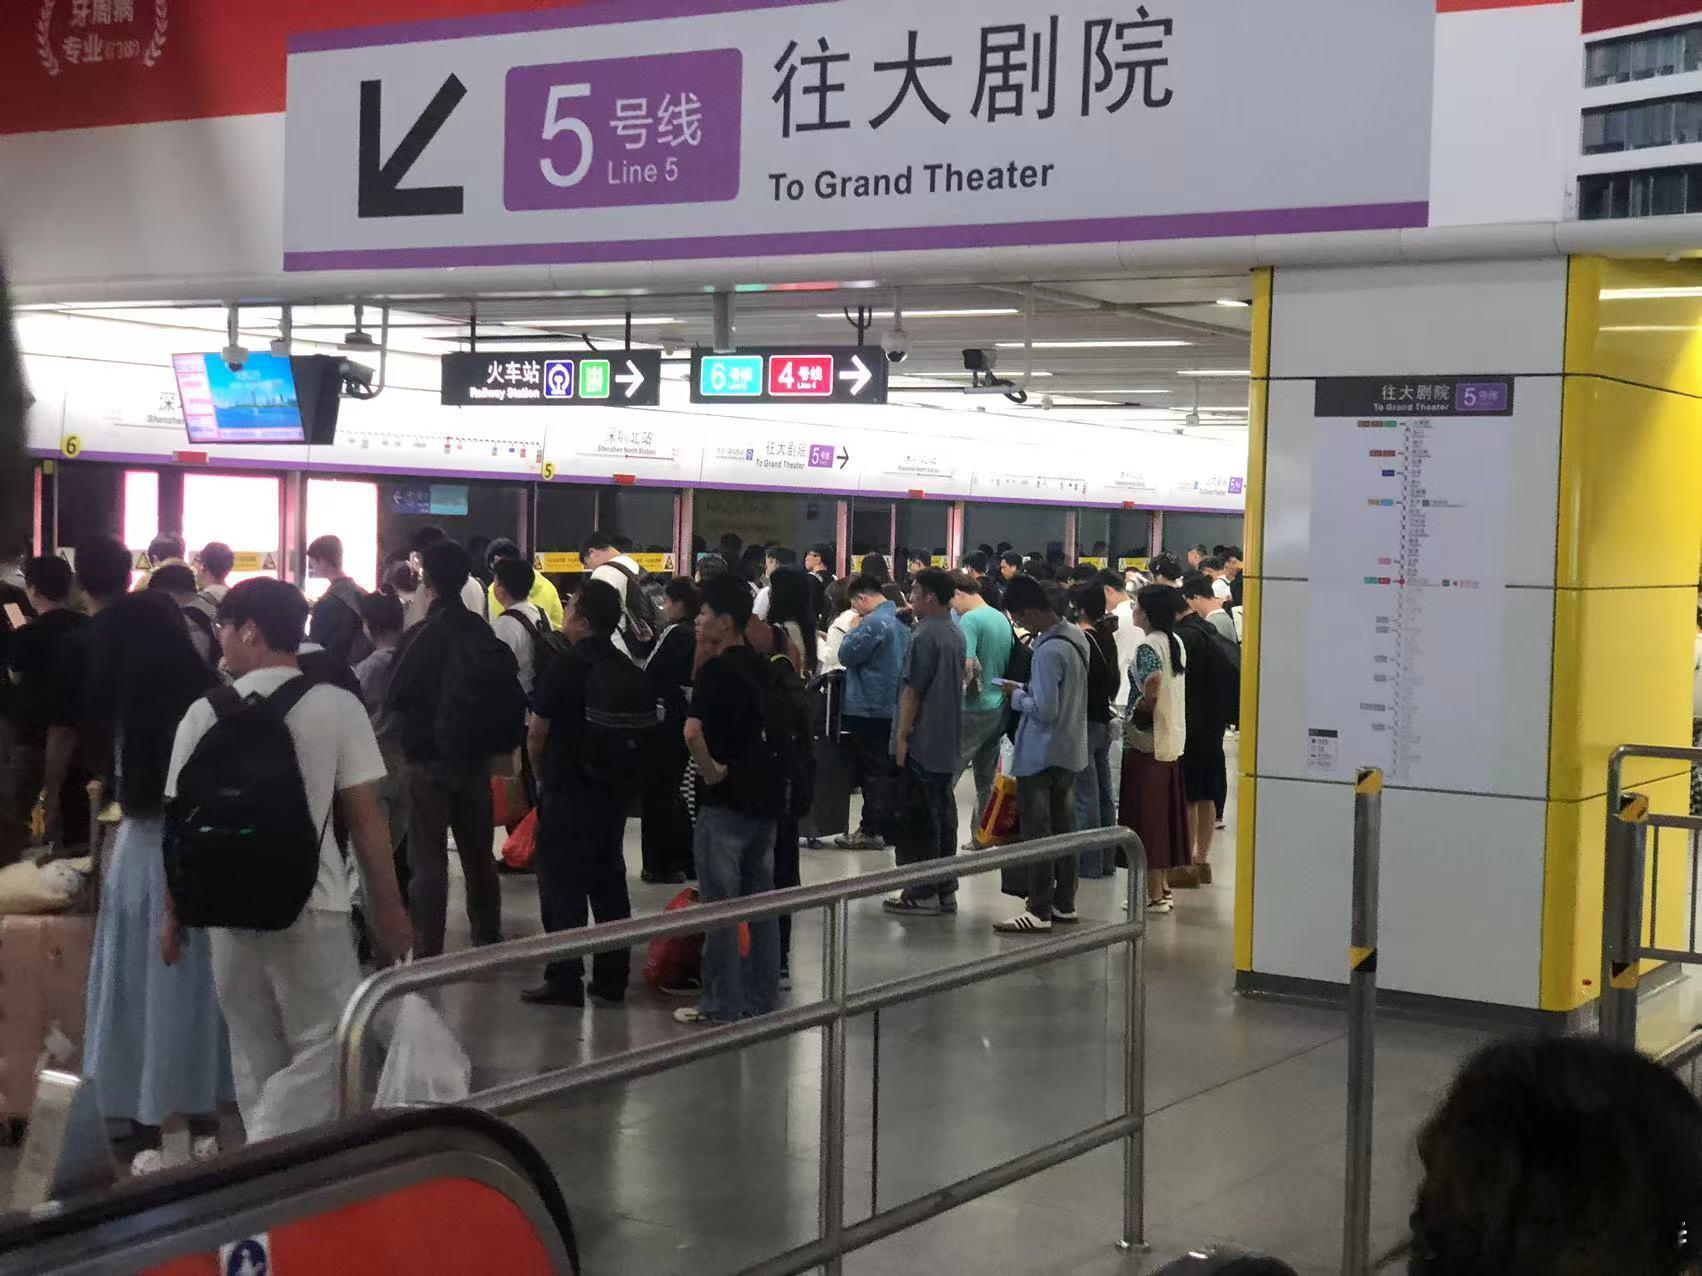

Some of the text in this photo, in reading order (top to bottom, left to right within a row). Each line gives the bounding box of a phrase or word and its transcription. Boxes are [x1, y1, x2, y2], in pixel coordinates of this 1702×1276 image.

[772, 5, 1173, 138] 往大剧院
[607, 156, 679, 184] Line 5
[768, 160, 1055, 201] To Grand Theater
[487, 360, 541, 384] 火车站
[506, 387, 540, 399] Station
[1382, 384, 1450, 400] 往大剧院
[1374, 402, 1449, 411] To Grand Theater
[66, 436, 77, 454] 6
[545, 463, 552, 478] 5
[764, 459, 782, 469] Grand
[783, 460, 805, 470] Theater
